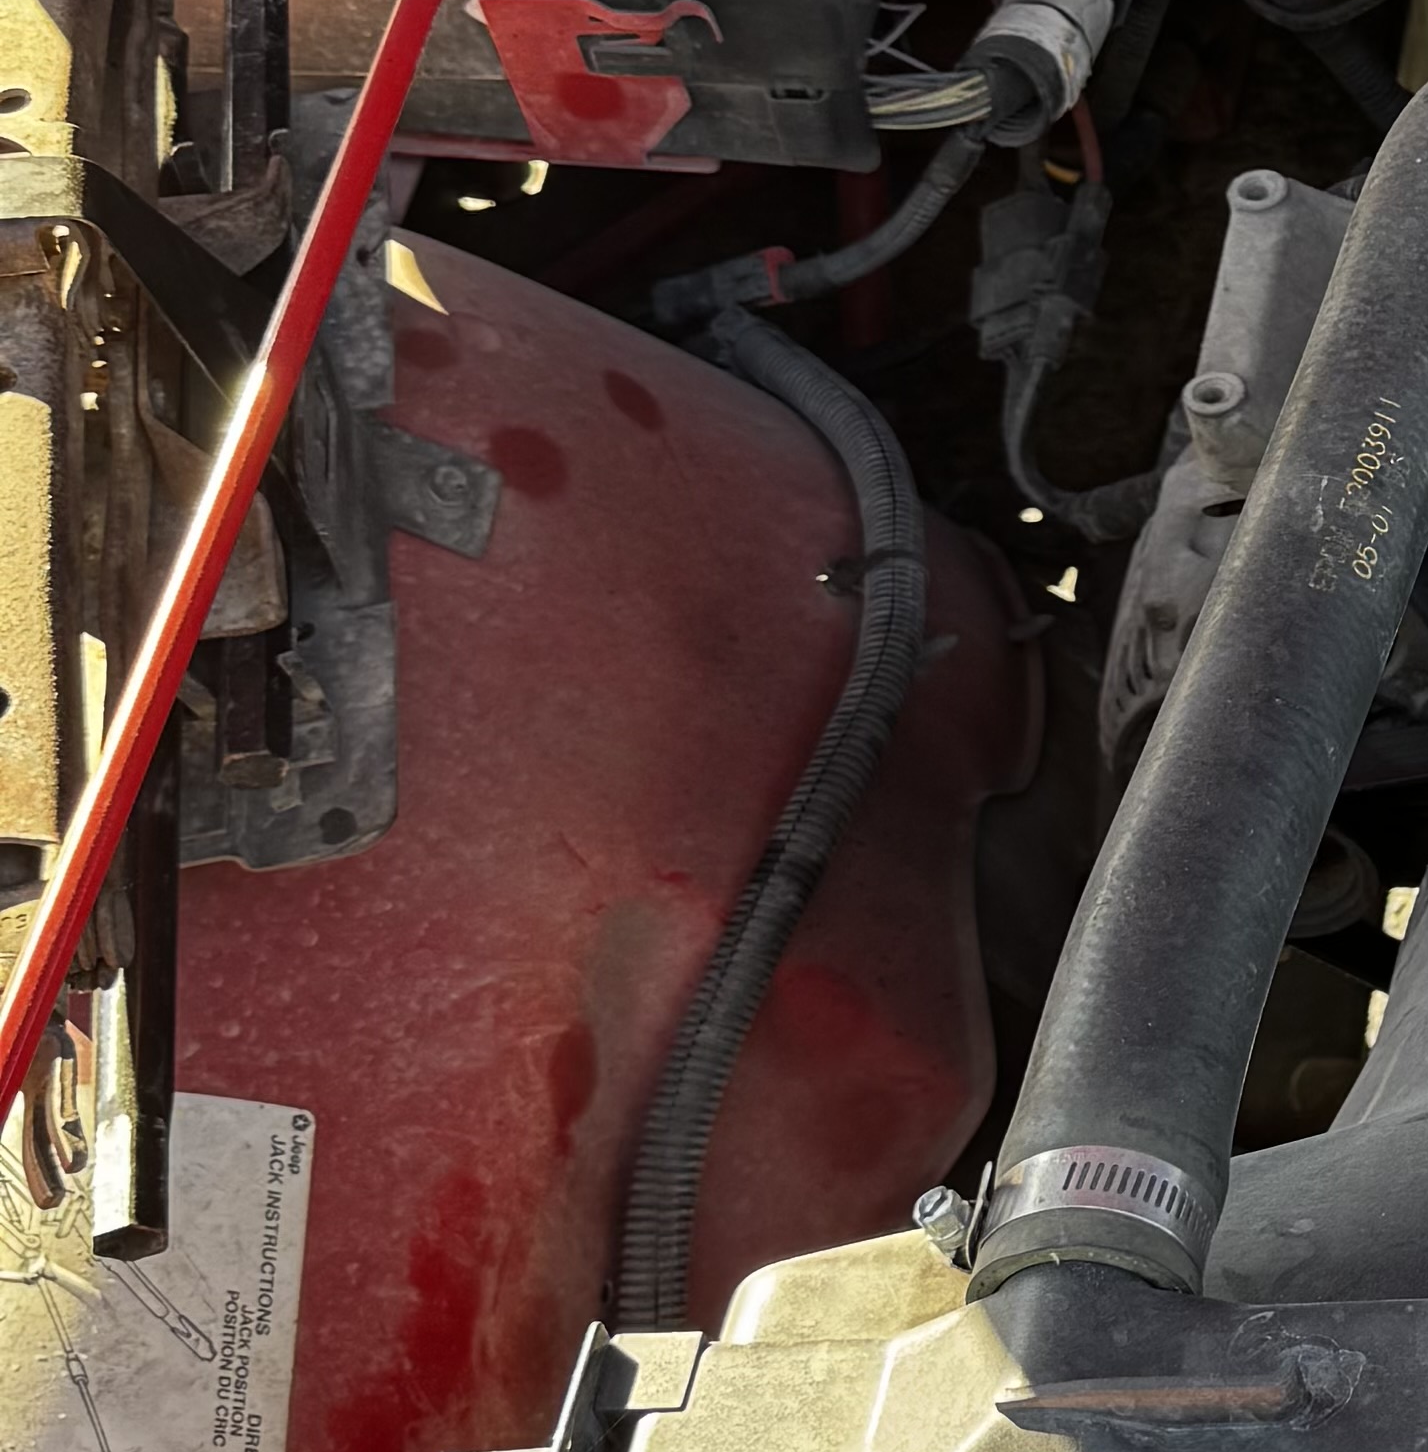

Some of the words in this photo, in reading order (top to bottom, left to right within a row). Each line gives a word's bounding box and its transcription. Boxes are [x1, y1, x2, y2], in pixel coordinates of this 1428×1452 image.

[265, 1134, 285, 1189] JACK
[289, 1135, 308, 1174] Jeep
[255, 1190, 284, 1337] INSTRUCTIONS
[218, 1288, 241, 1371] POSITION
[236, 1303, 253, 1352] JACK
[216, 1374, 232, 1401] DU
[229, 1353, 251, 1438] POSITION
[211, 1407, 228, 1448] CRIC
